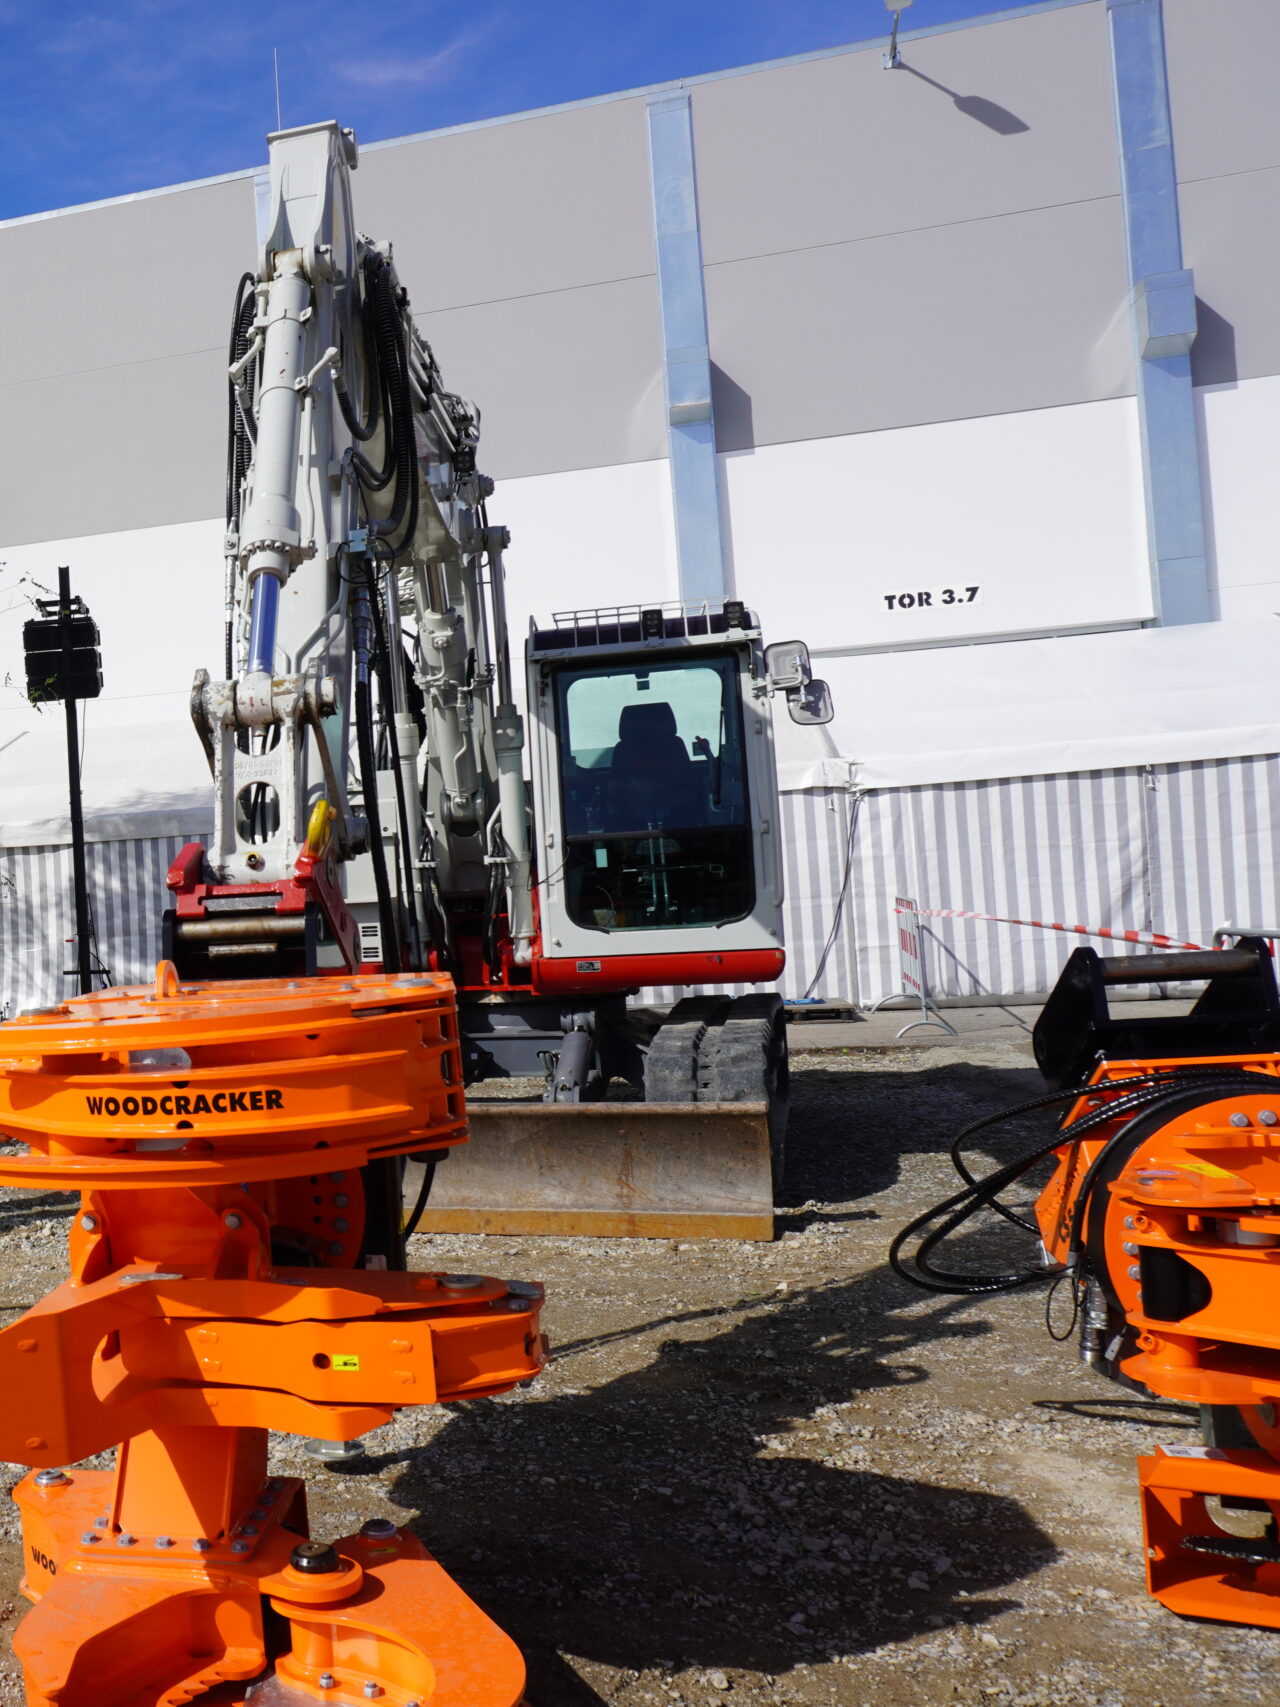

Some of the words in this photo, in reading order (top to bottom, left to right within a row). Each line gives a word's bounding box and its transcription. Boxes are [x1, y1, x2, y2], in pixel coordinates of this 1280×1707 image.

[884, 591, 933, 610] TOR
[942, 586, 979, 605] 3.7
[86, 1089, 284, 1116] WOODCRACKER
[31, 1545, 57, 1576] WOO
